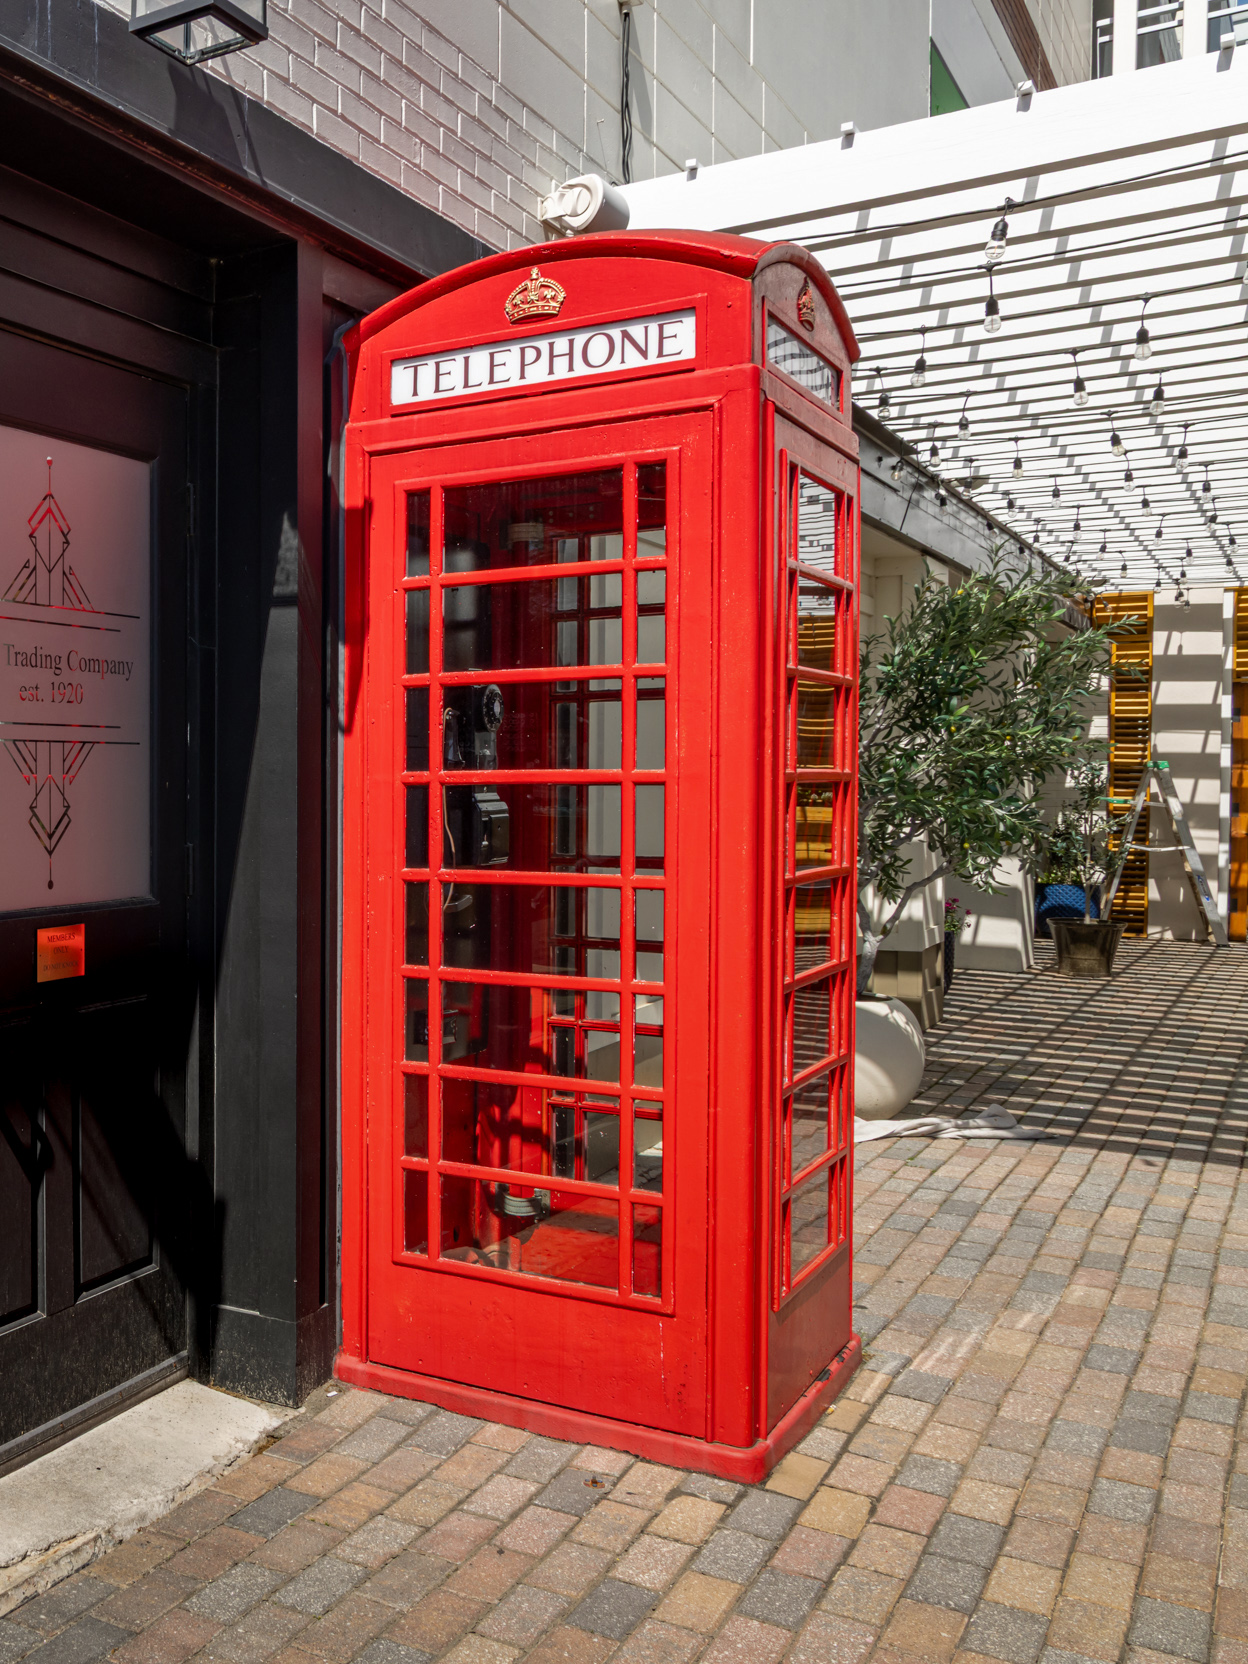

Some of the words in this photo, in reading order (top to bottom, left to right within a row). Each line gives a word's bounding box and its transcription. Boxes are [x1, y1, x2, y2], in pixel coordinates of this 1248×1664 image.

[403, 319, 684, 398] TELEPHONE
[3, 643, 62, 676] Trading
[67, 649, 134, 682] Company
[19, 683, 44, 702] est.
[50, 681, 84, 705] 1920
[47, 932, 76, 943] MEMBERS
[53, 945, 69, 955] ONLY
